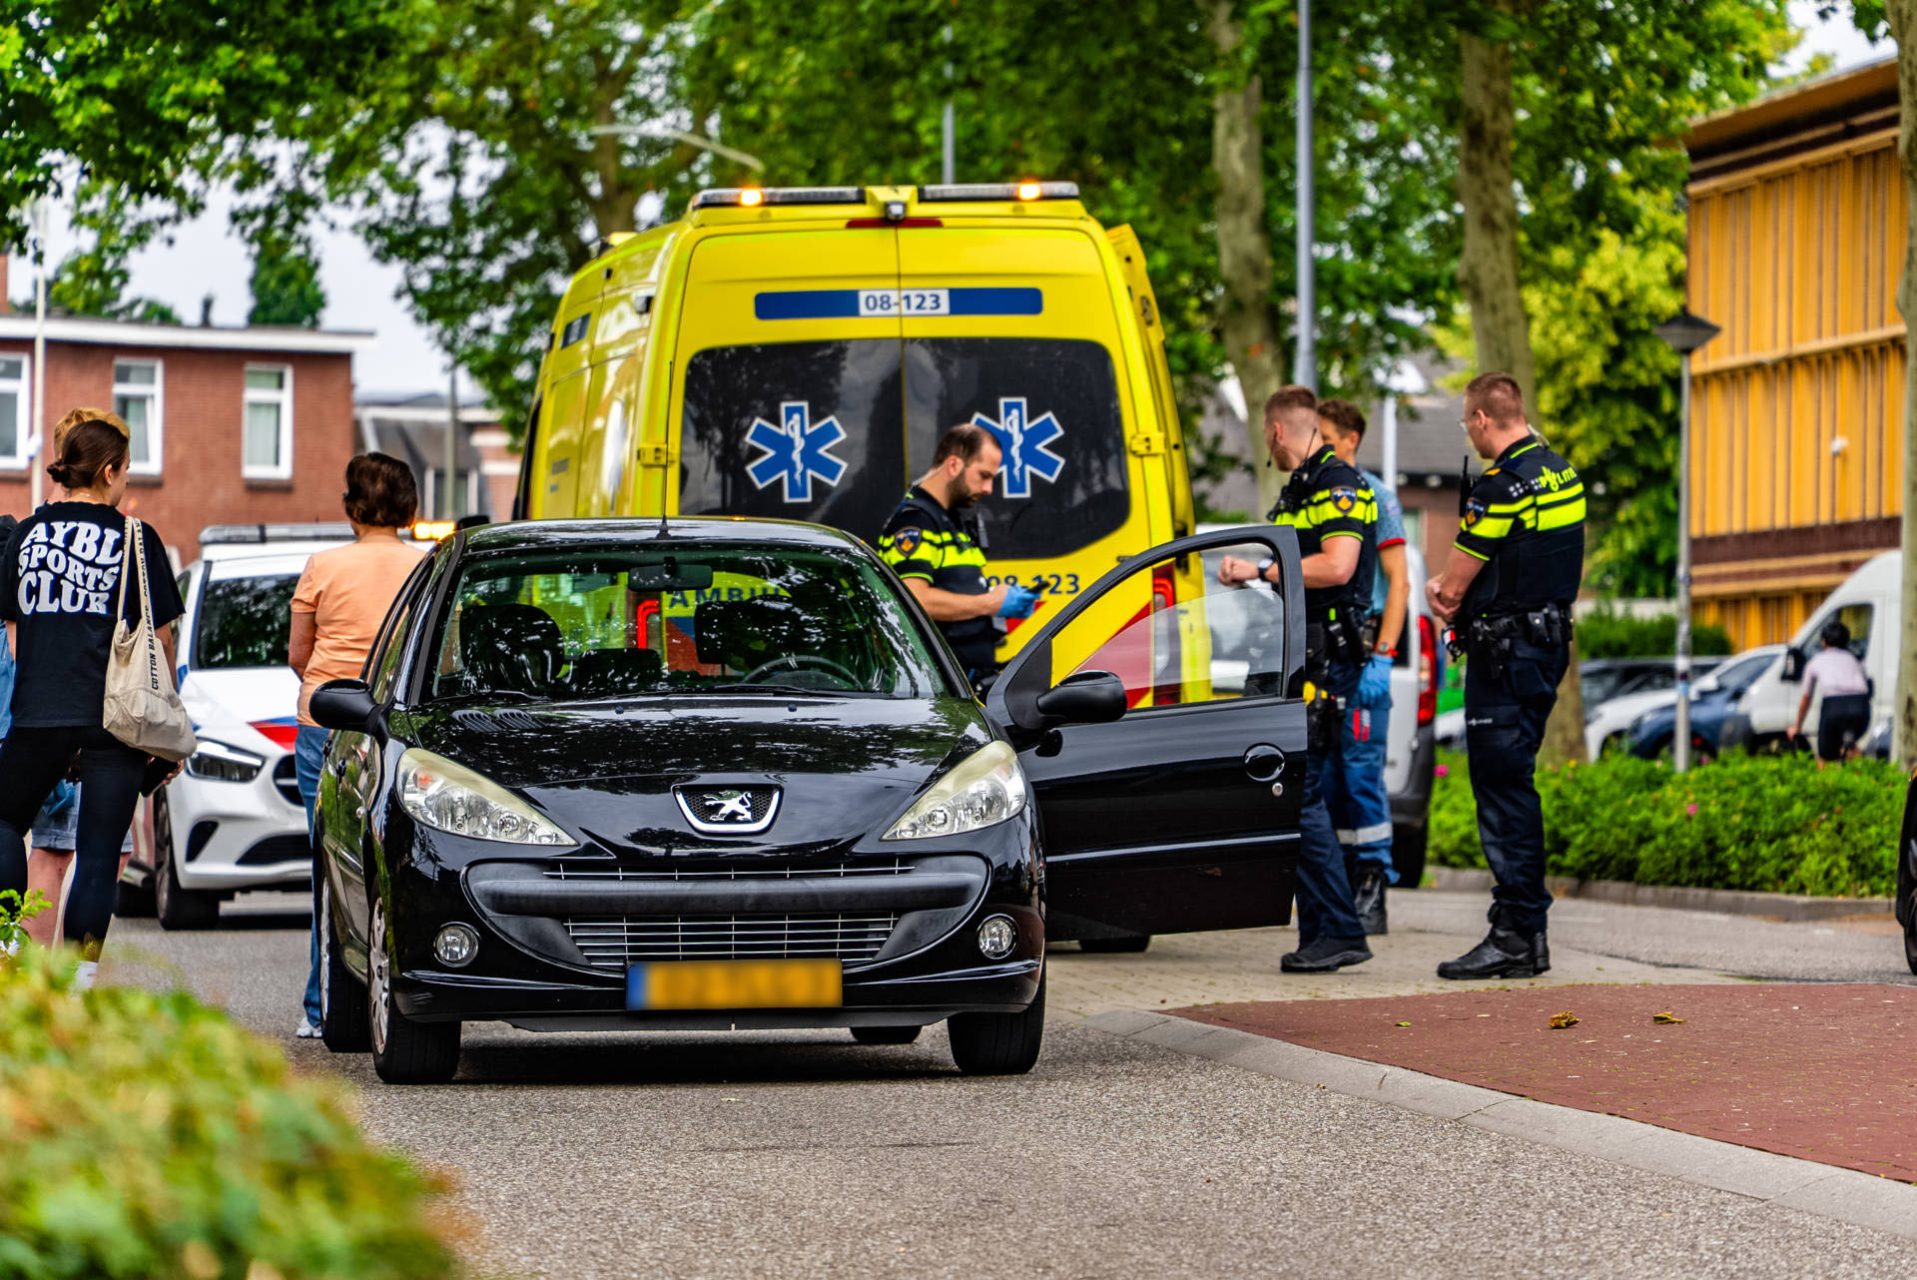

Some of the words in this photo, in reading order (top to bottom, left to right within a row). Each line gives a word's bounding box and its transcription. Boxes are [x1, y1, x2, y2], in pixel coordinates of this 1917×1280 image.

[864, 293, 942, 312] 08-123
[20, 521, 123, 565] AYBL
[18, 544, 120, 592] SPORTS
[149, 653, 159, 691] COTTON
